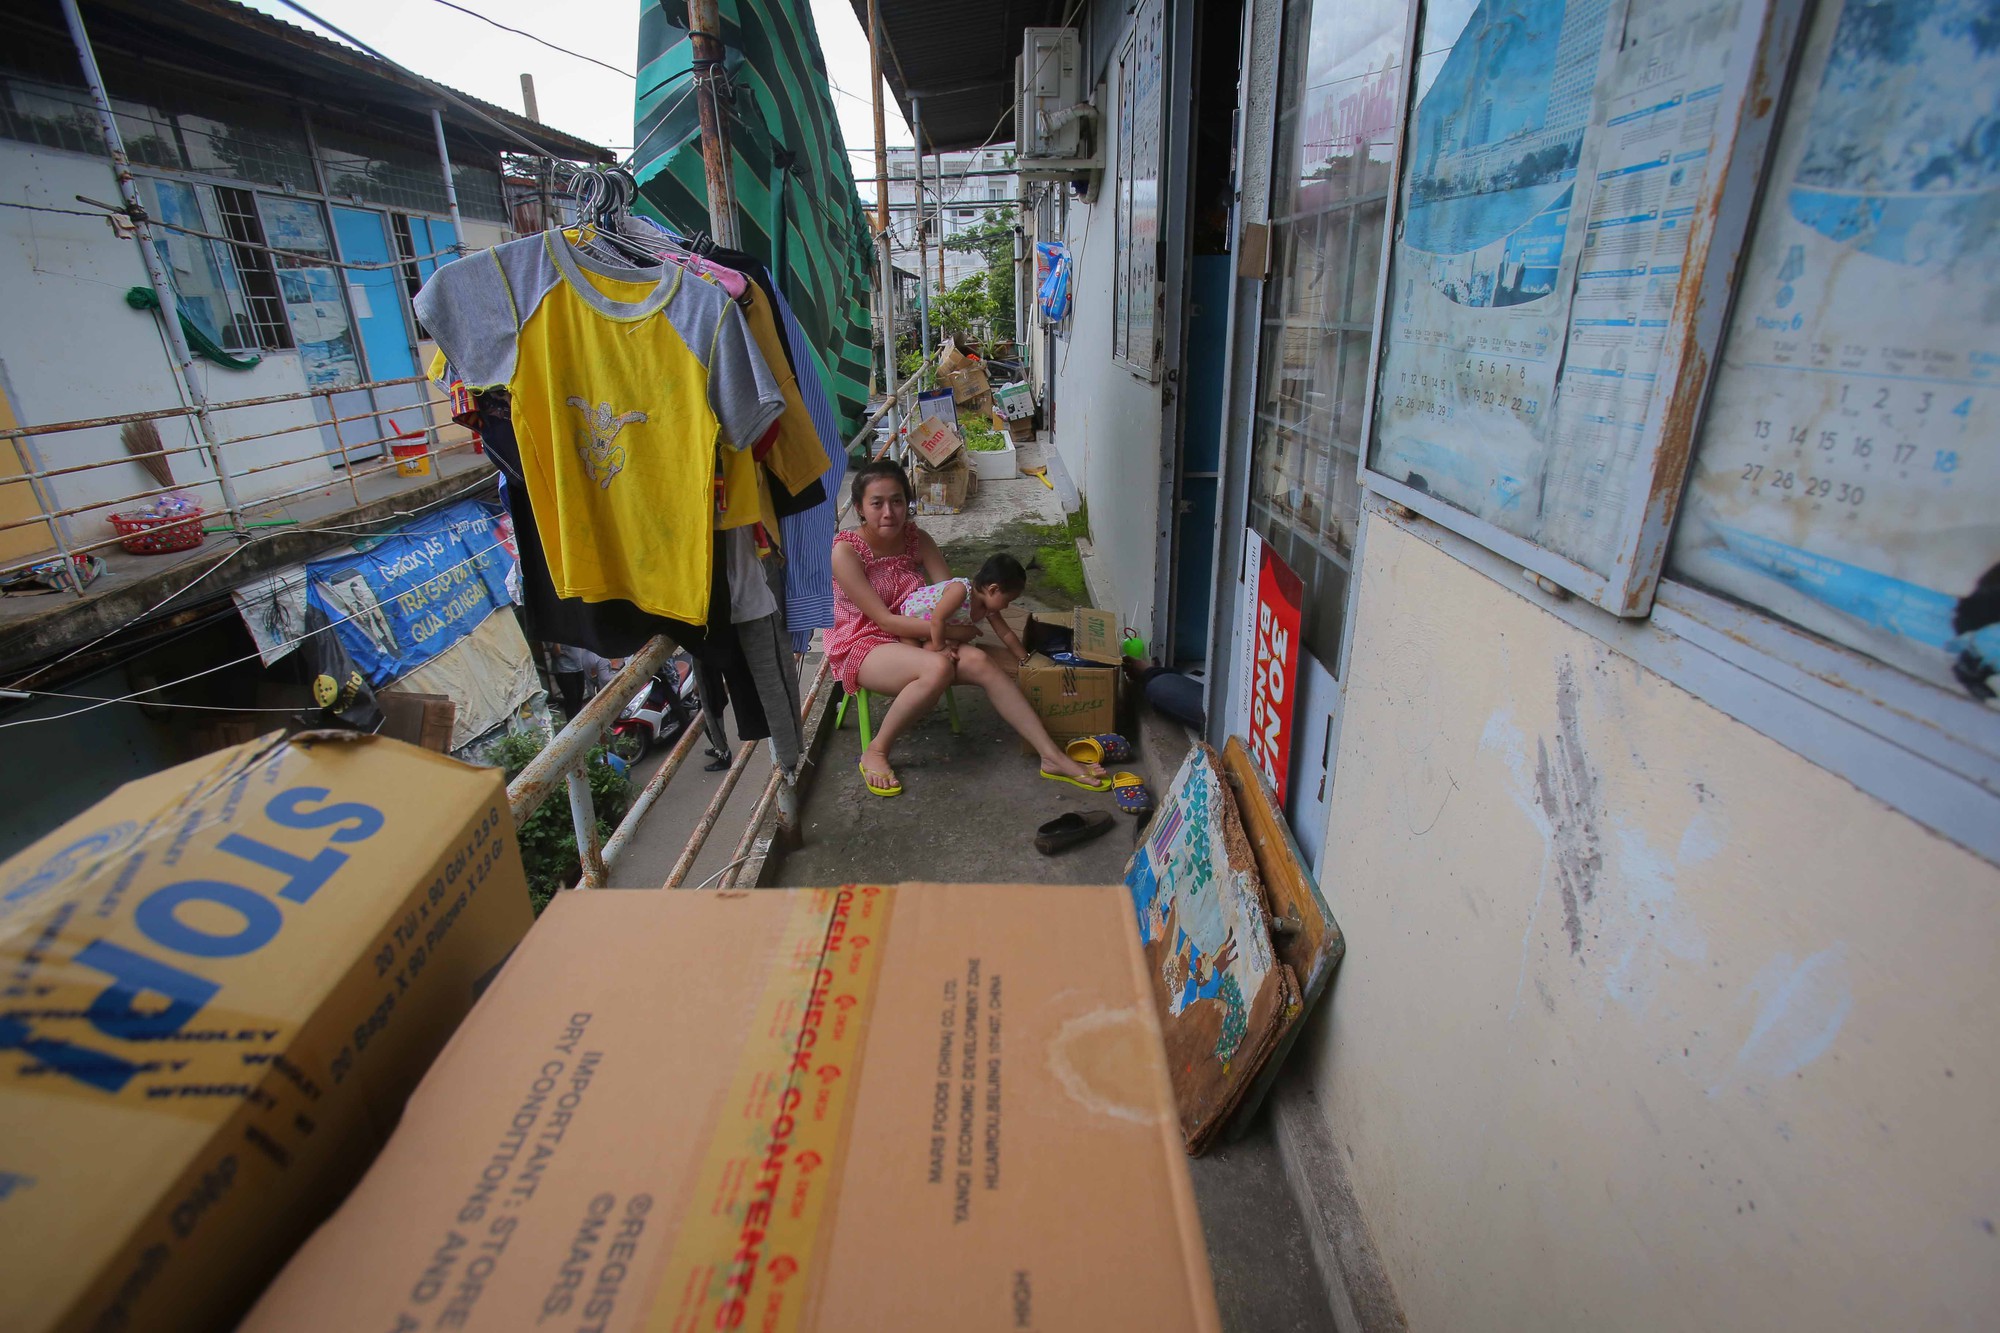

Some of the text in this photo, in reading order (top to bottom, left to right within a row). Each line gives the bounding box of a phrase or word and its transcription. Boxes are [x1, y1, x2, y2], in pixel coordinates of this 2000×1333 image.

[1791, 313, 1804, 331] 6
[1395, 396, 1404, 407] 25
[1406, 398, 1415, 409] 26
[1417, 400, 1425, 411] 27
[1427, 402, 1435, 414] 28
[1438, 404, 1446, 416] 29
[1840, 384, 1974, 417] 1 2 3 4
[1755, 420, 1959, 473] 13 14 15 16 17 18
[1741, 463, 1866, 506] 27 28 29 30
[1254, 599, 1272, 730] BẢNG
[1264, 616, 1289, 796] 30 NĂ
[428, 880, 447, 914] 90
[407, 935, 428, 971] 90
[989, 973, 1002, 1012] CHINA
[555, 1011, 593, 1055] DRY
[787, 967, 834, 1076] CHECK
[933, 1081, 950, 1133] FOODS
[954, 957, 981, 1227] YANQI ECONOMIC DEVELOPMENT ZONE
[458, 1057, 567, 1224] CONDITIONS
[928, 1134, 946, 1185] MARS
[715, 1086, 803, 1332] CONTENTS
[408, 1229, 469, 1308] AND
[440, 1213, 520, 1333] STORE
